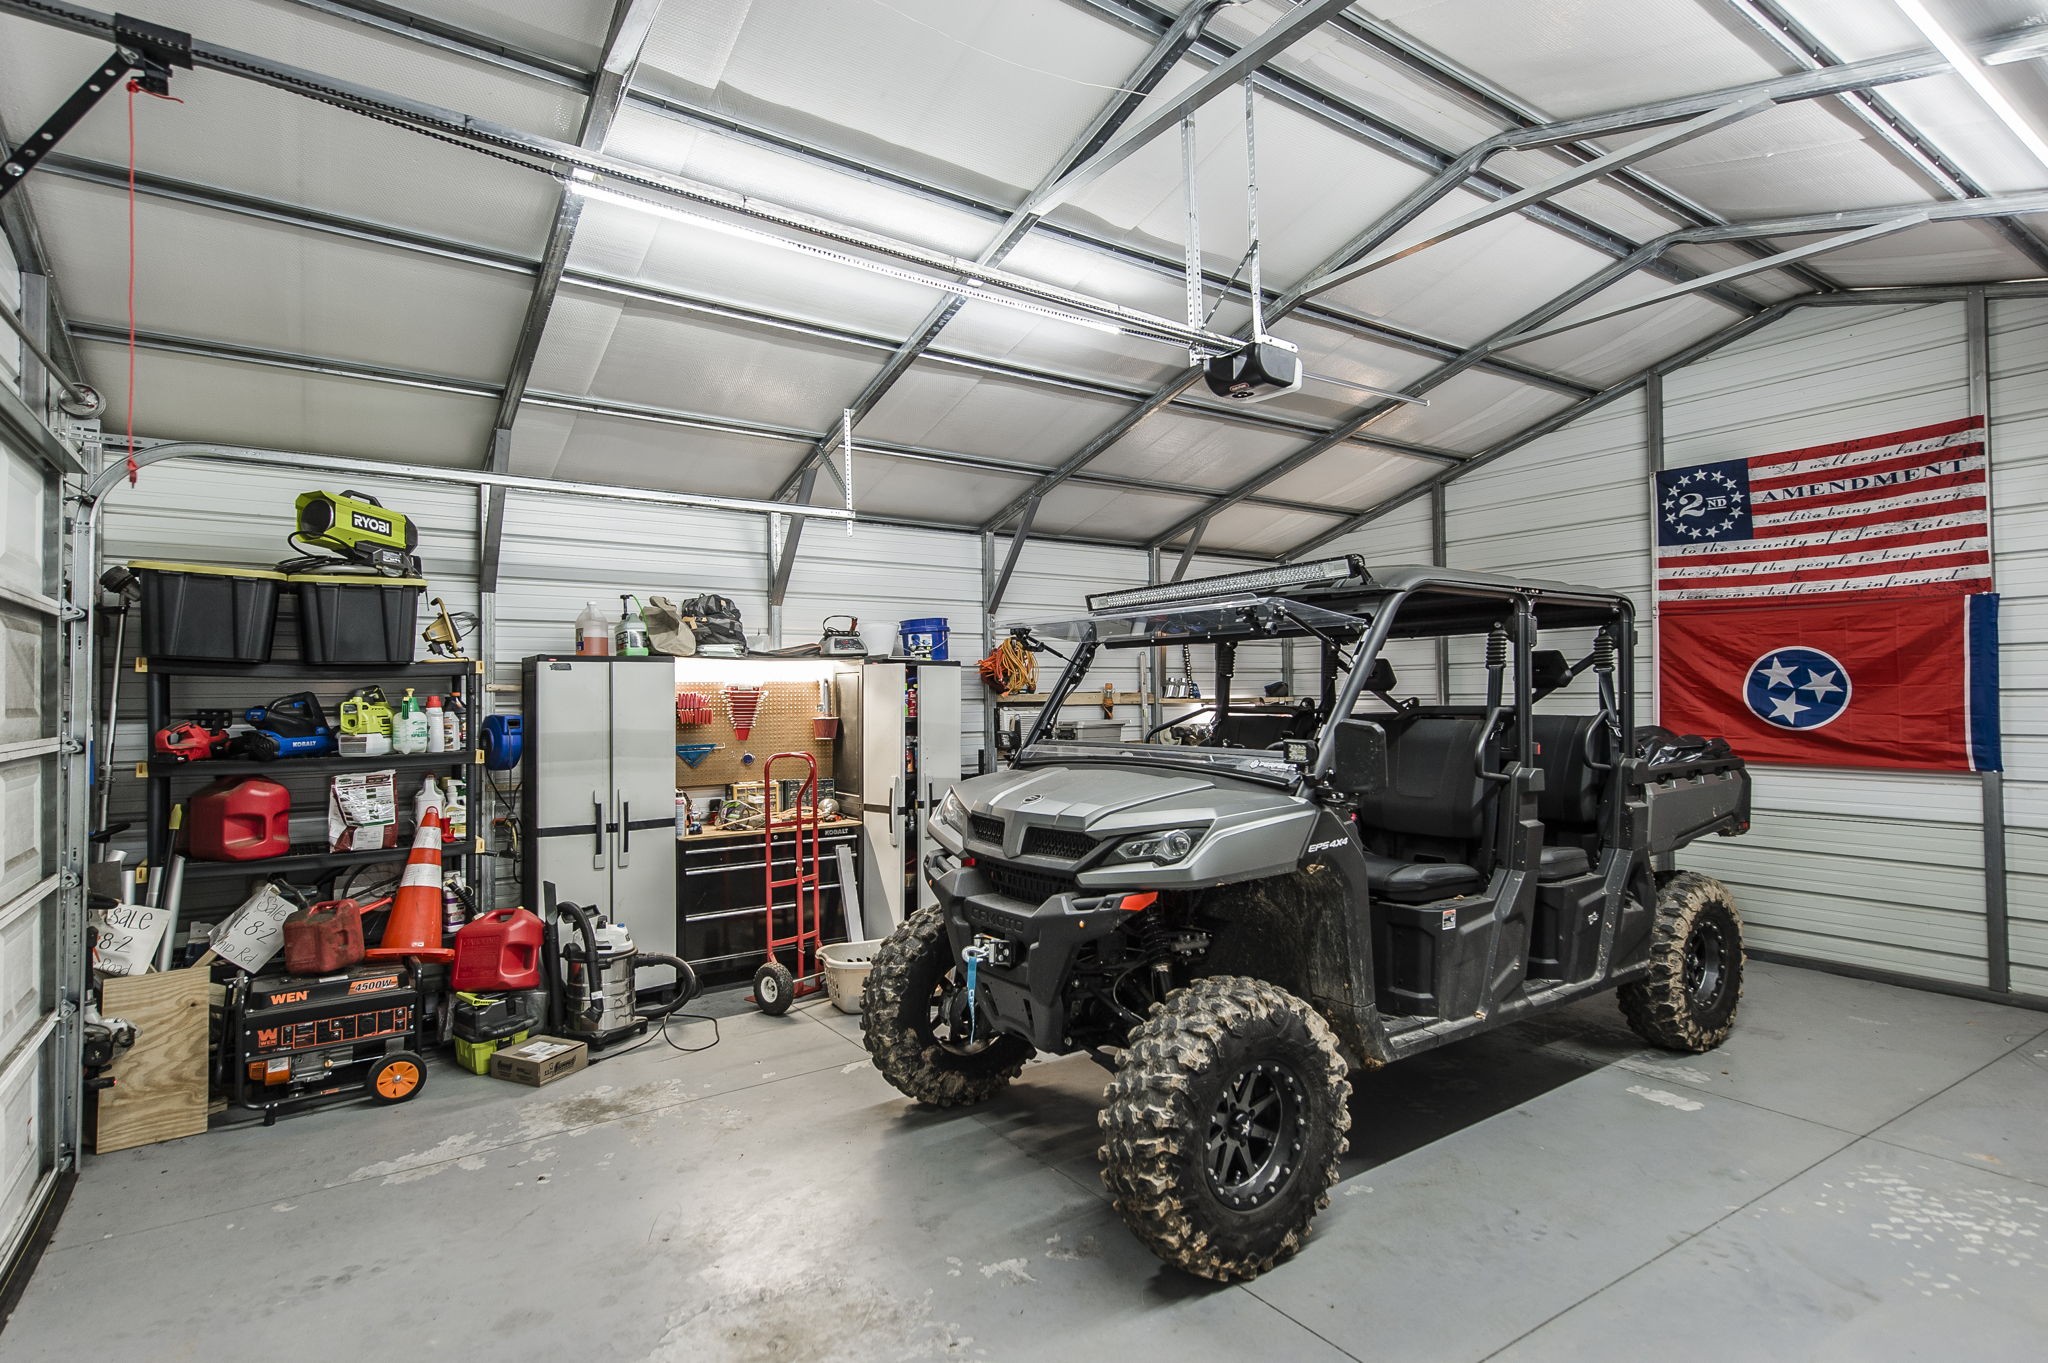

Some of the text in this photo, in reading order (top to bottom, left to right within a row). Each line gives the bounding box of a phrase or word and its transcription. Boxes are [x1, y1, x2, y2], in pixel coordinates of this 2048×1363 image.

[1809, 453, 1849, 469] well
[1852, 436, 1951, 465] regulated
[1762, 458, 1967, 502] AMENDMENT
[1768, 492, 1962, 524] militia being necessary
[353, 513, 390, 534] RYOBI
[1681, 518, 1962, 555] to the security of a free state,
[1672, 540, 1967, 577] the right of the people to keep and
[1677, 590, 1713, 600] bear
[1715, 591, 1754, 599] arms
[1761, 584, 1807, 596] shall
[1808, 585, 1837, 593] not
[1841, 580, 1861, 590] be
[292, 740, 317, 748] KOBALT
[824, 828, 849, 836] KOBALT
[1308, 837, 1349, 852] EPS 4X4
[257, 896, 287, 922] Sale
[99, 932, 134, 953] 8-2
[244, 920, 277, 944] 8-2
[233, 947, 258, 964] Rd
[354, 978, 392, 992] 4500W
[270, 991, 309, 1005] WEN
